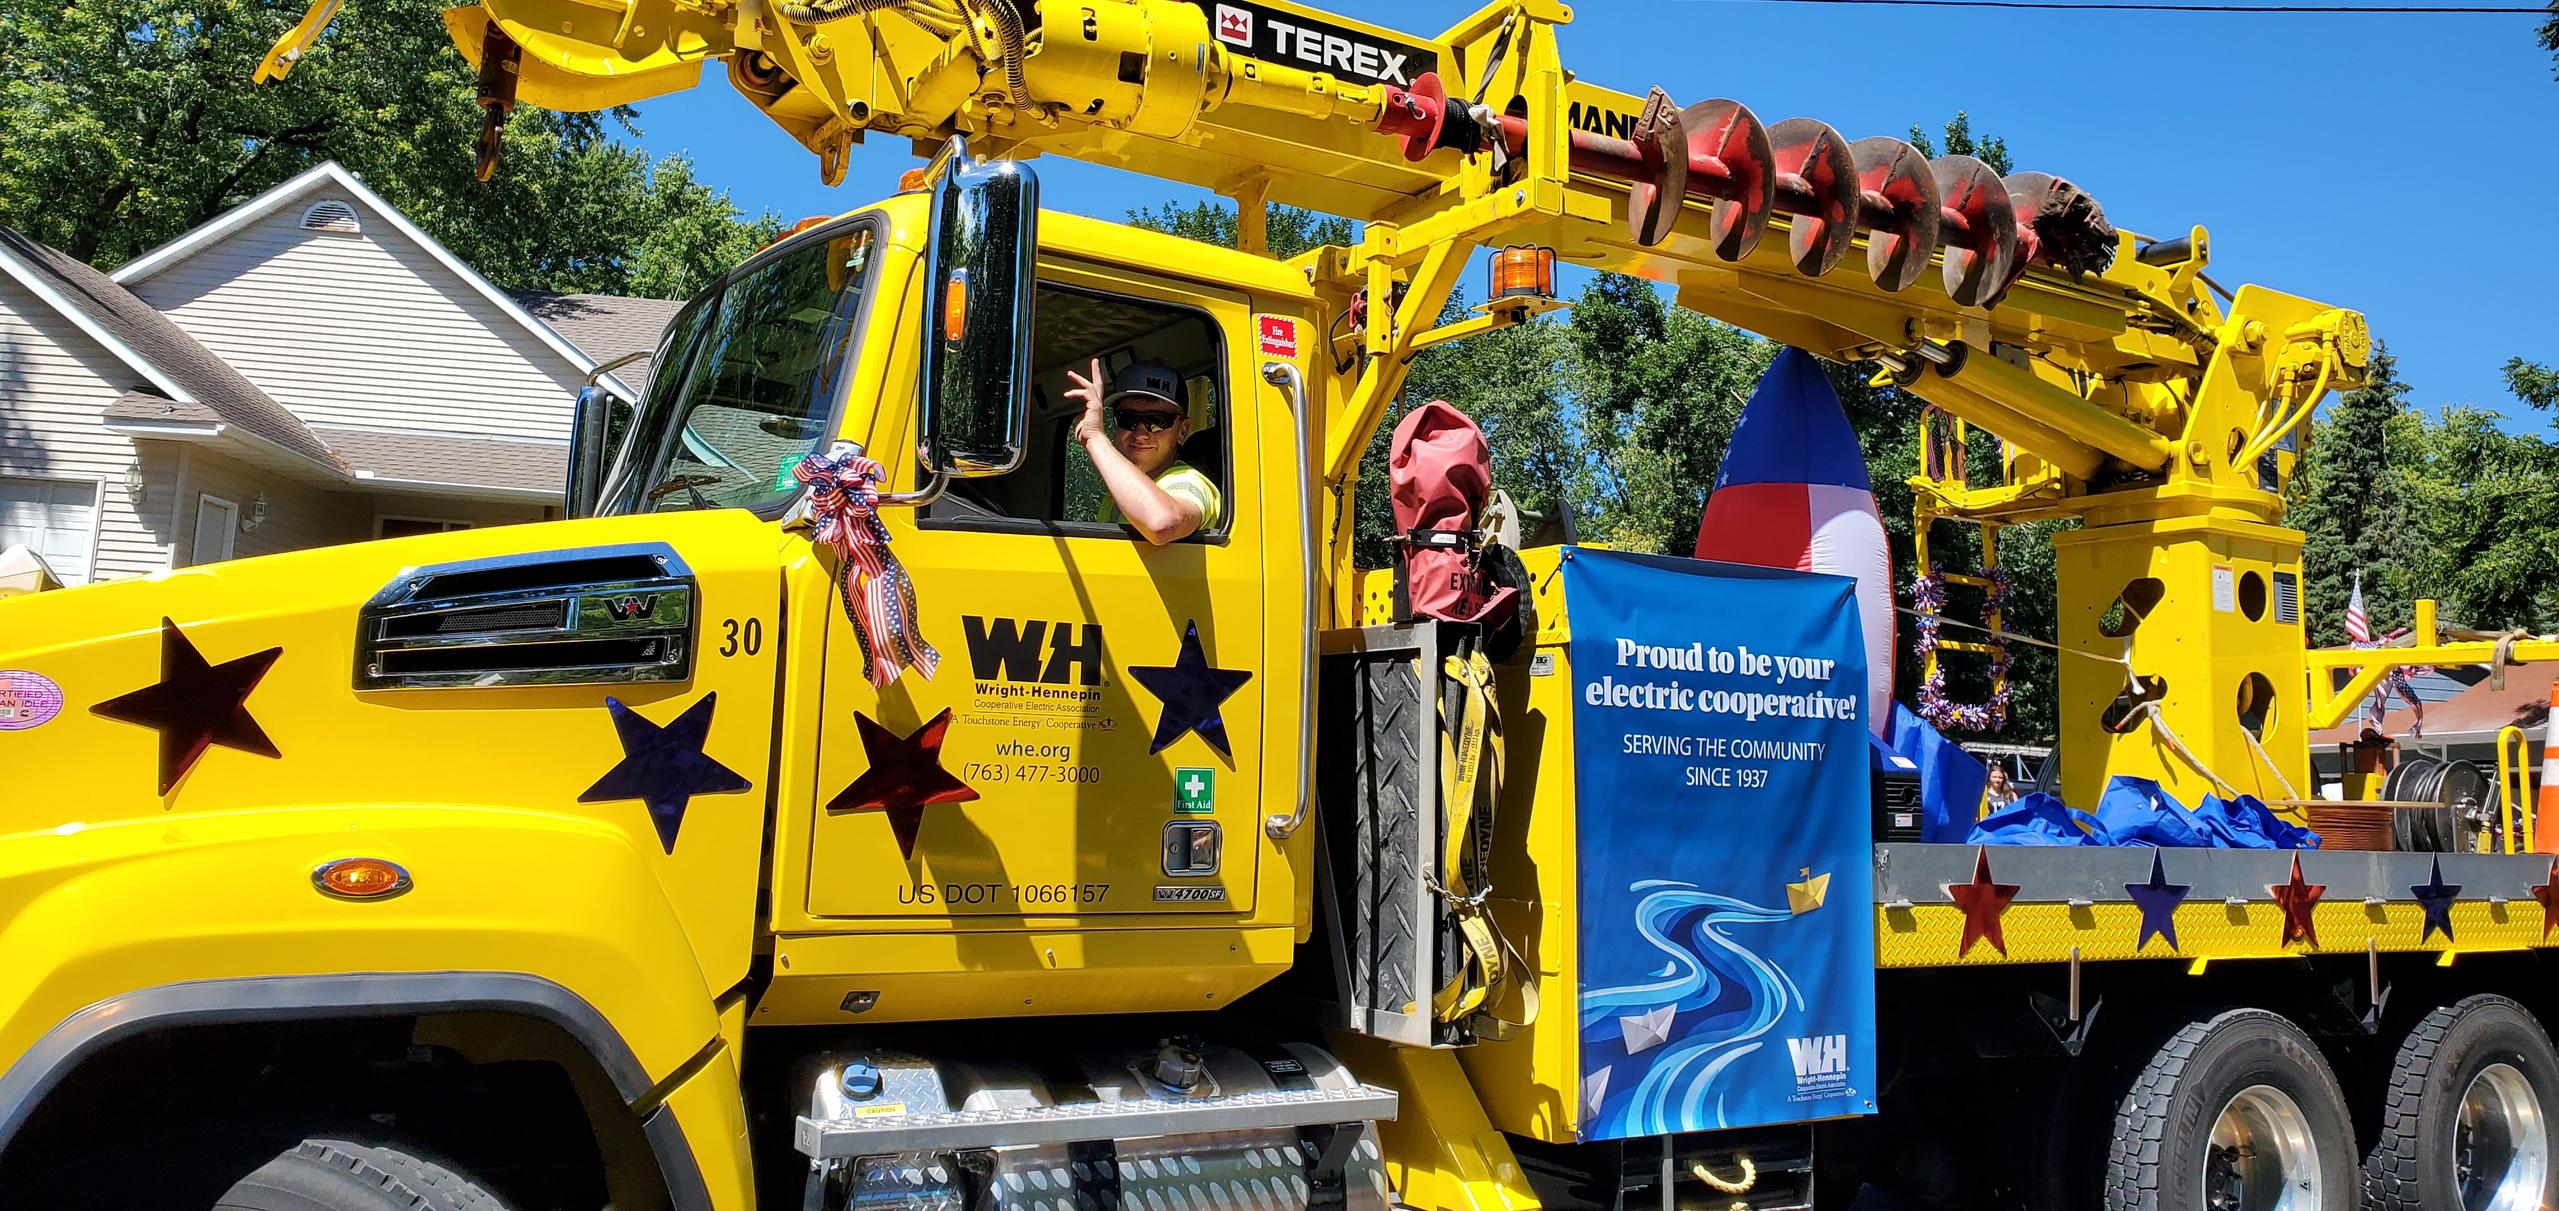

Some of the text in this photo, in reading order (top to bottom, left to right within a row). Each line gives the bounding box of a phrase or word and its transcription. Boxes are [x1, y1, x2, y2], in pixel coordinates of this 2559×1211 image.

[1268, 20, 1408, 86] TEREX
[719, 617, 762, 658] 30
[962, 615, 1102, 686] WH
[1615, 638, 1835, 684] Proud to be your
[0, 690, 42, 698] RTIFIED
[975, 683, 1101, 702] Wright-Hennepin
[1585, 676, 1857, 721] electric cooperative!
[22, 700, 48, 708] IDLE
[974, 699, 1100, 713] Cooperative Electric Association
[962, 714, 1010, 726] Touchstone
[1046, 718, 1096, 730] Cooperative
[996, 740, 1070, 762] whe.org
[1623, 734, 1826, 761] SERVING THE COMMUNITY
[964, 762, 1100, 784] (763) 477-3000
[1686, 766, 1768, 788] SINCE 1937
[1177, 800, 1211, 809] First Aid
[898, 884, 1110, 904] US DOT 1066157
[1787, 1034, 1846, 1076] WH
[1796, 1072, 1846, 1084] Wright-Hennepin
